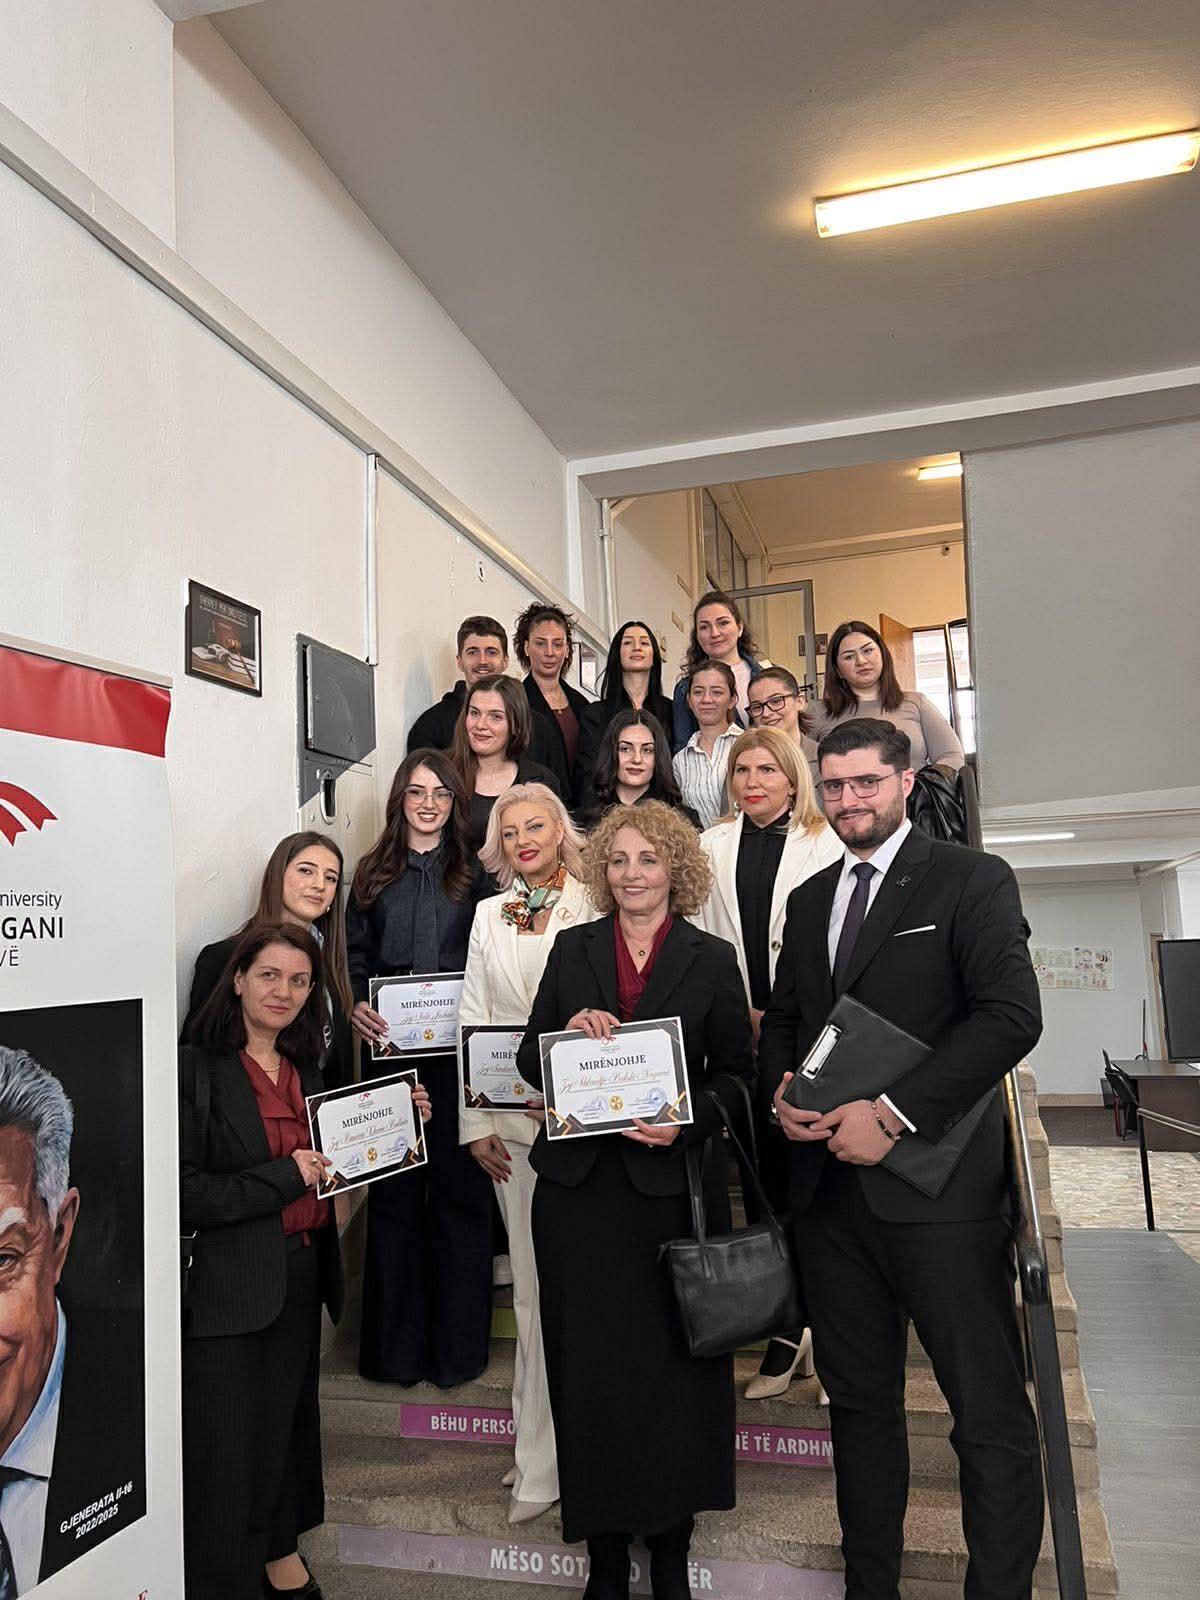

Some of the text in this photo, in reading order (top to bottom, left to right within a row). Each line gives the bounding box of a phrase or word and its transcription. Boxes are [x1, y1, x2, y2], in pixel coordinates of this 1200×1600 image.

[401, 998, 456, 1009] MIRËNJOHJE
[579, 1054, 647, 1071] MIRËNJOHJE
[342, 1107, 393, 1128] MIRËNJOHJE
[431, 1412, 467, 1432] BËHU
[472, 1418, 516, 1435] PERSO
[753, 1432, 771, 1453] TË
[776, 1437, 833, 1457] ARDHM
[60, 1492, 115, 1534] GJENERATA
[75, 1503, 119, 1539] 2022/2025
[490, 1544, 543, 1574] MËSO
